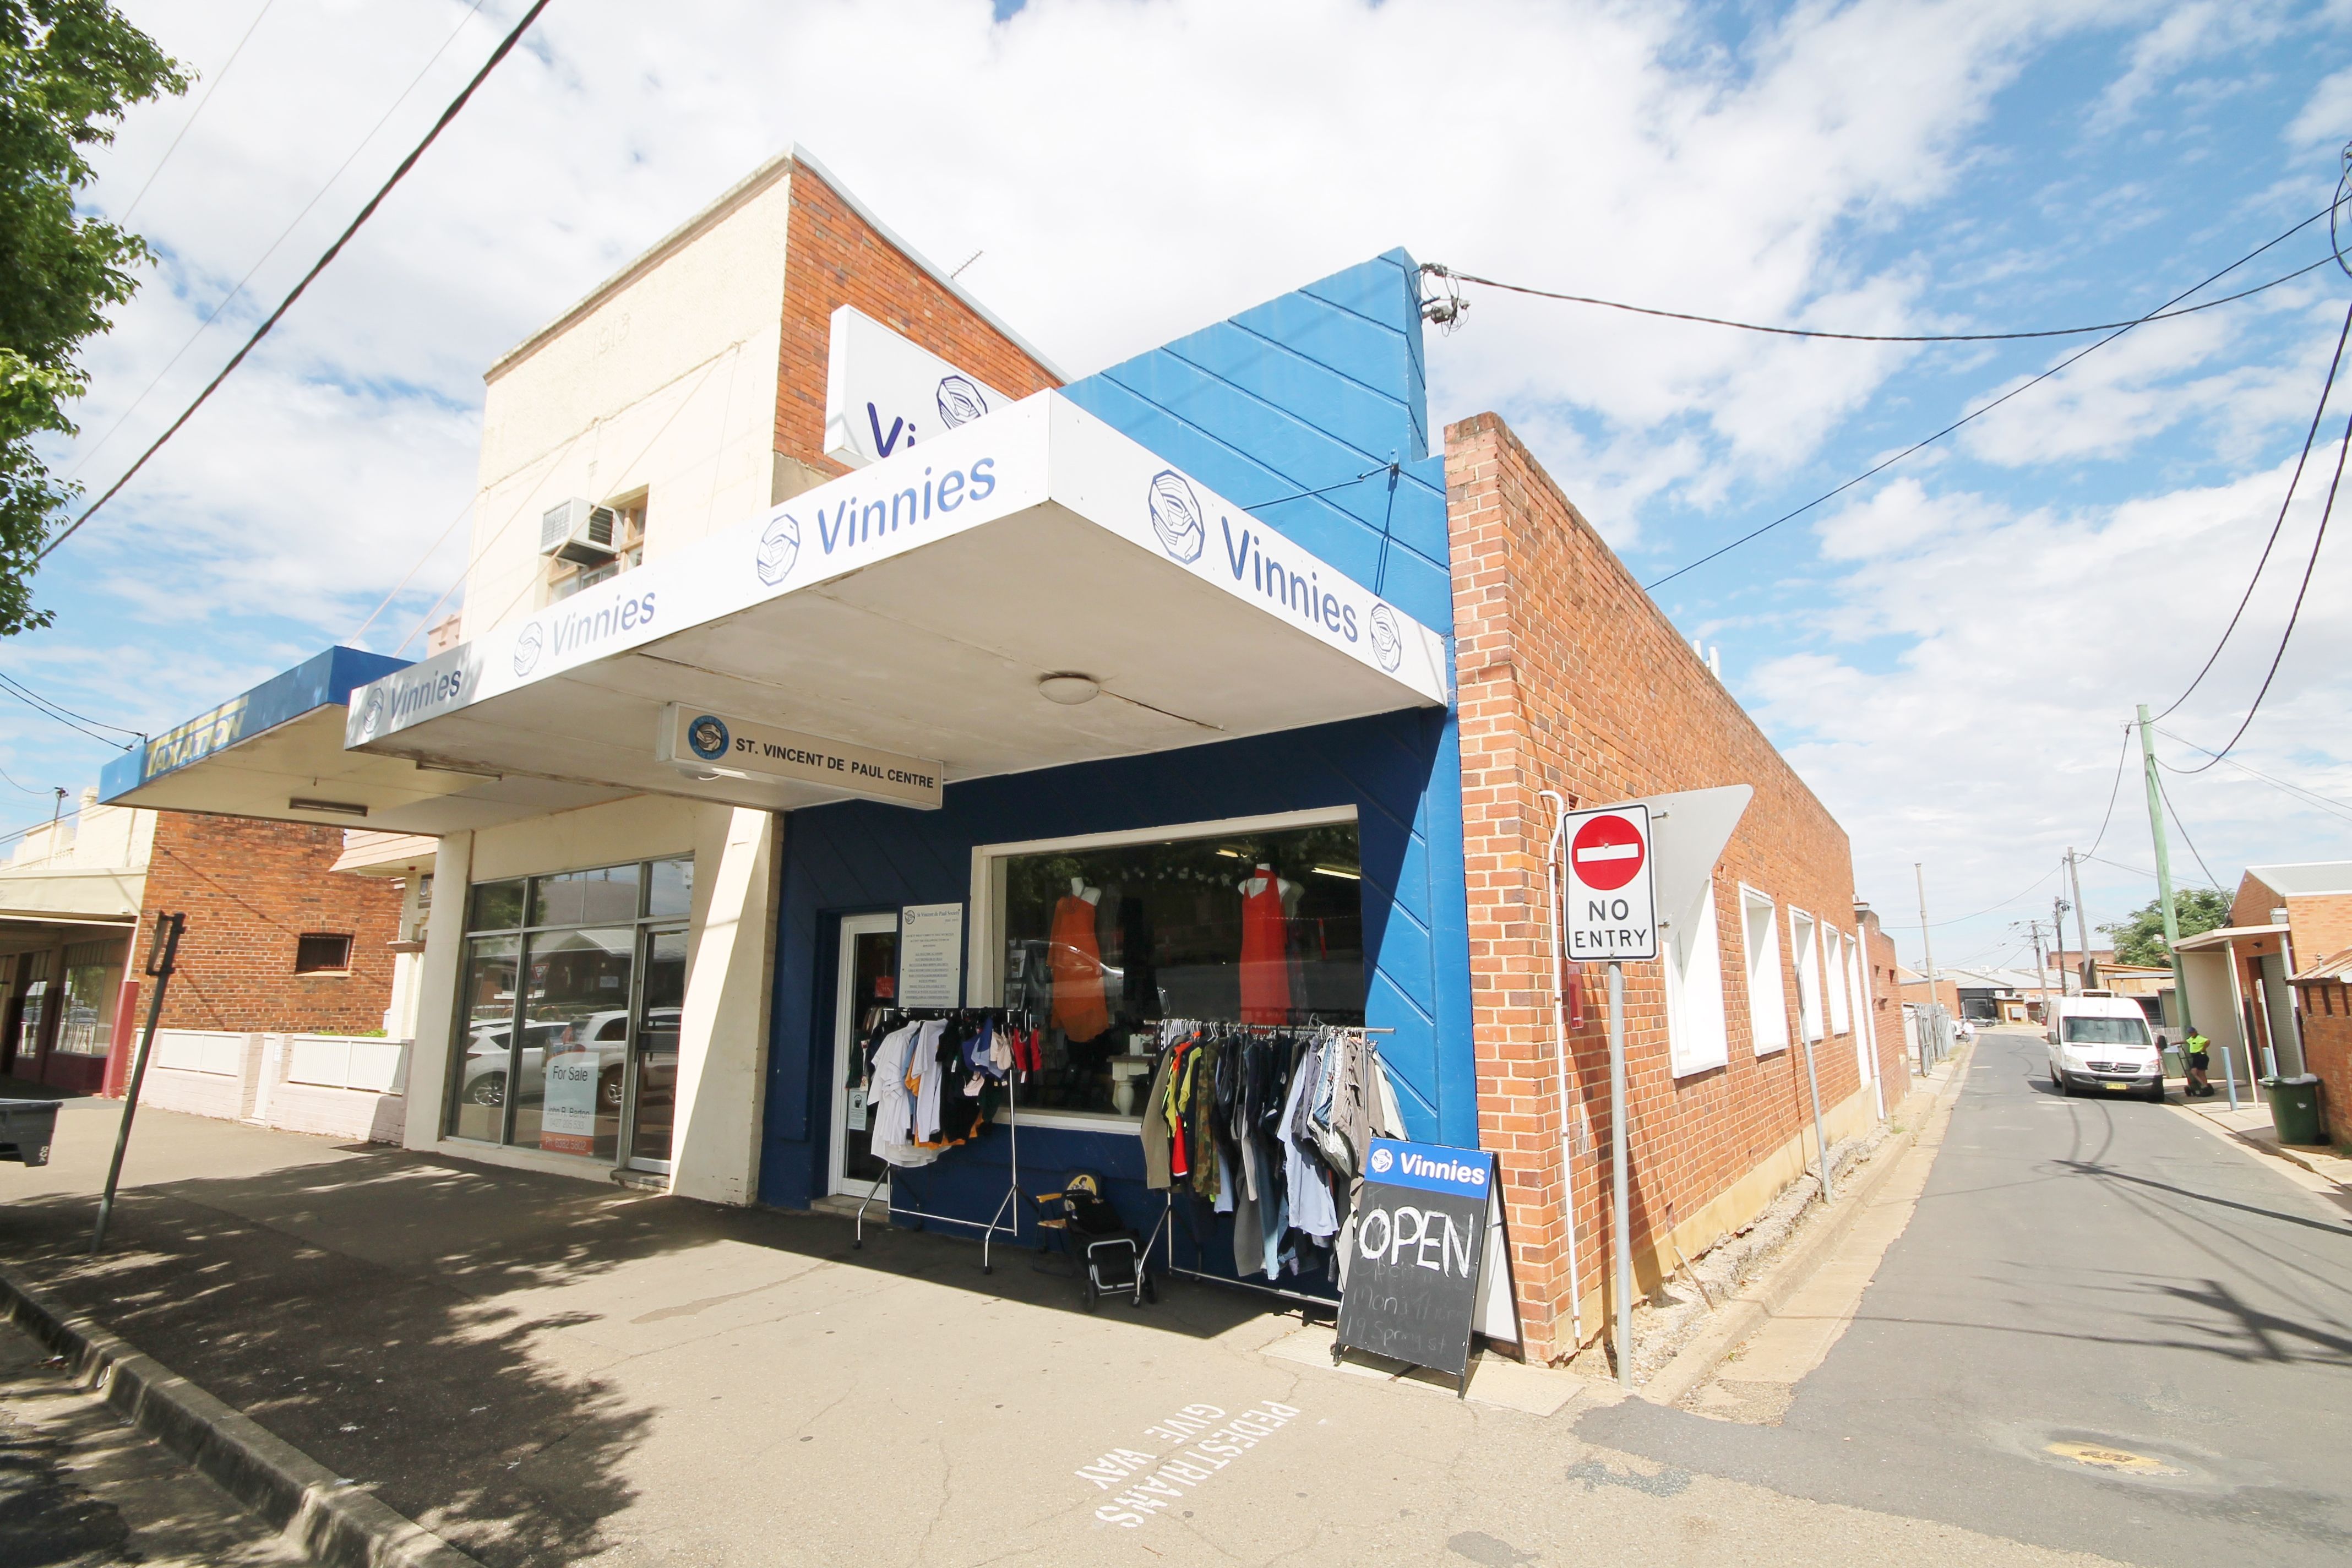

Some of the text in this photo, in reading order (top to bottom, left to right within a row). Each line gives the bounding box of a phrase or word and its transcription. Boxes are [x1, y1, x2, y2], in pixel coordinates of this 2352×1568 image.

[818, 456, 996, 556] Vinnies
[1222, 515, 1358, 643] Vinnies
[553, 591, 656, 657] Vinnies
[390, 669, 461, 717] Vinnies
[736, 738, 759, 755] ST.
[763, 743, 824, 767] VINCENT
[827, 756, 845, 771] DE
[851, 761, 884, 778] PAUL
[887, 769, 934, 789] CENTRE
[1575, 929, 1647, 948] ENTRY
[1588, 899, 1629, 921] NO
[553, 1065, 588, 1082] For Sale
[1400, 1152, 1486, 1185] Vinnies
[1358, 1205, 1474, 1278] OPEN
[1074, 1403, 1226, 1490] GIVE WAY
[1095, 1400, 1301, 1528] PEDESTRIANS
